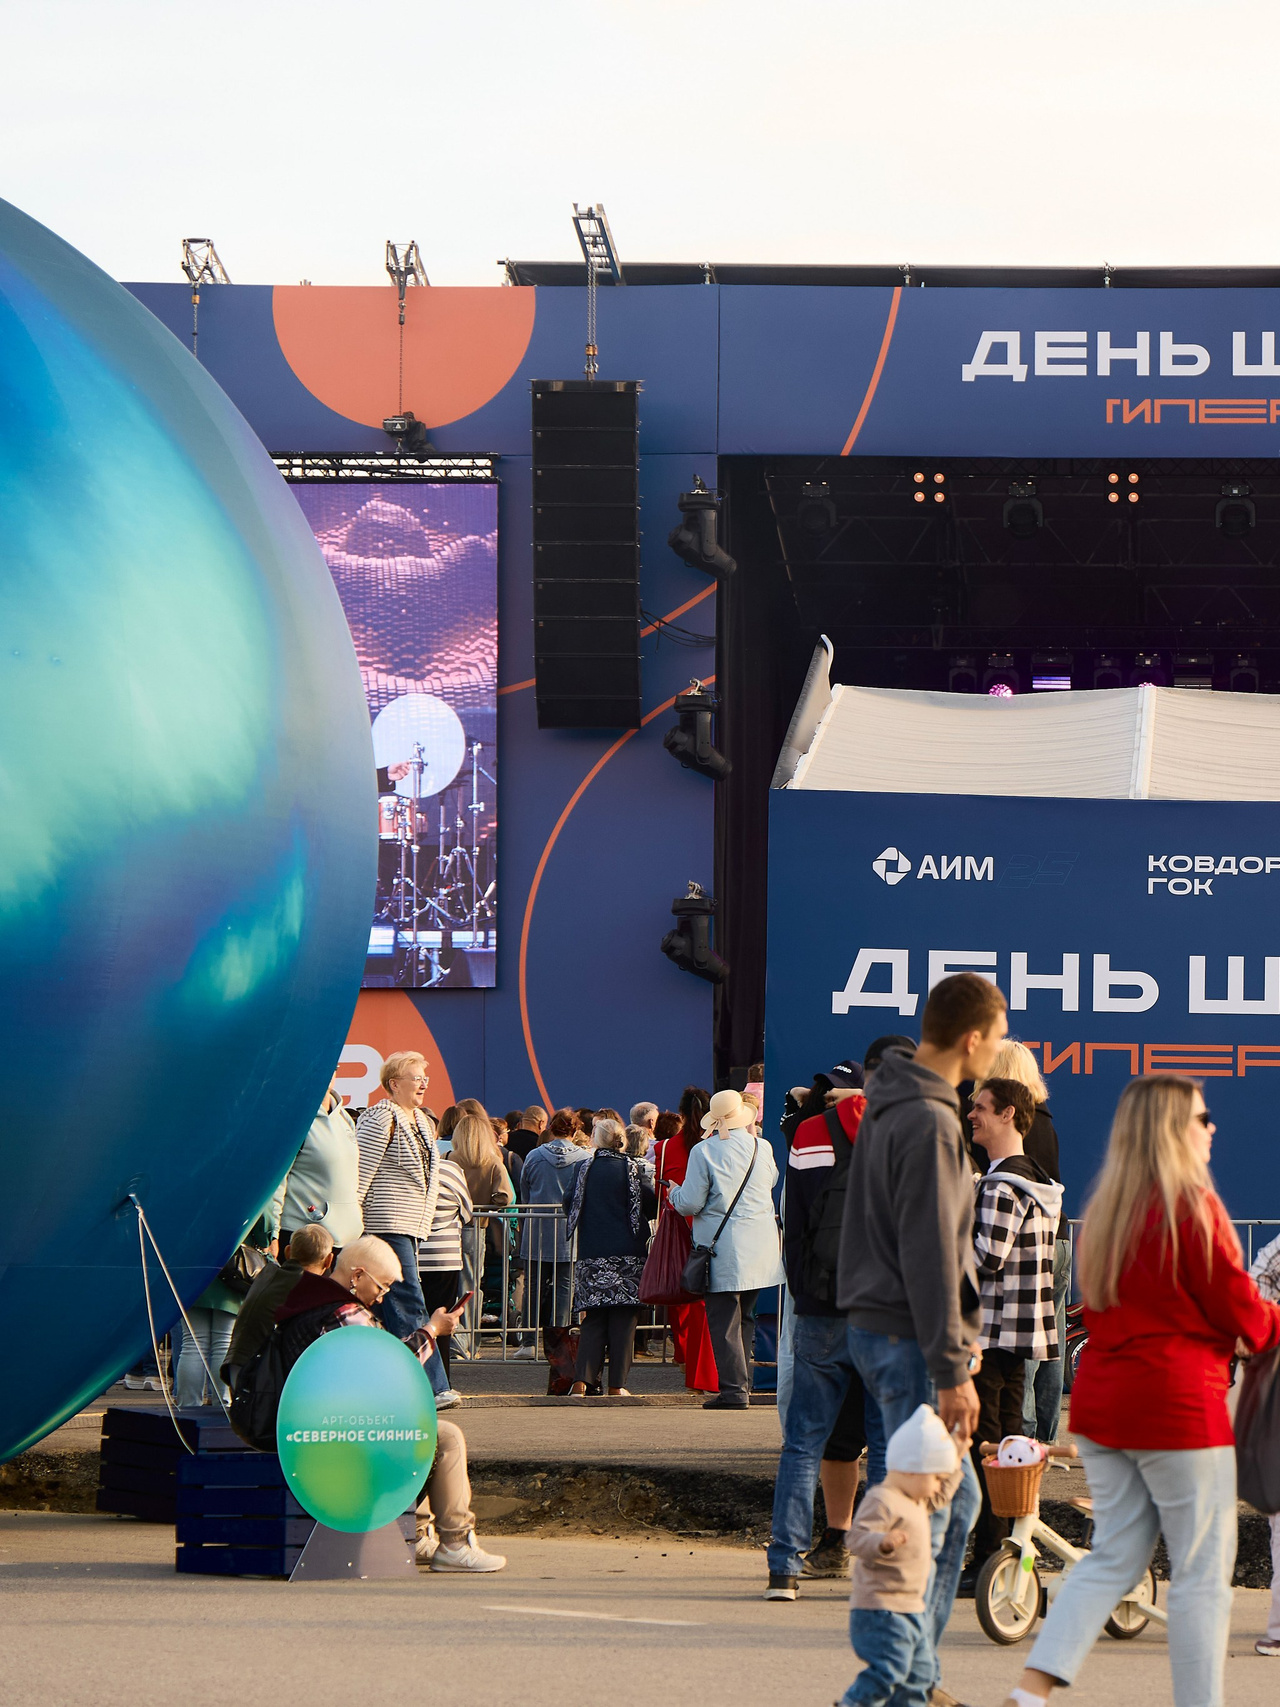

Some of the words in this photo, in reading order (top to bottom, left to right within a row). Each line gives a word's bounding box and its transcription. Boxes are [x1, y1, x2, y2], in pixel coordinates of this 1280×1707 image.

[961, 330, 1211, 382] ДЕНЬ
[916, 854, 994, 881] АИМ
[1147, 877, 1214, 896] ГОК
[321, 1415, 396, 1426] АРТ-ОБЪЕКТ
[285, 1430, 365, 1443] «СЕВЕРНОЕ
[367, 1429, 429, 1442] СИЯНИЕ»
